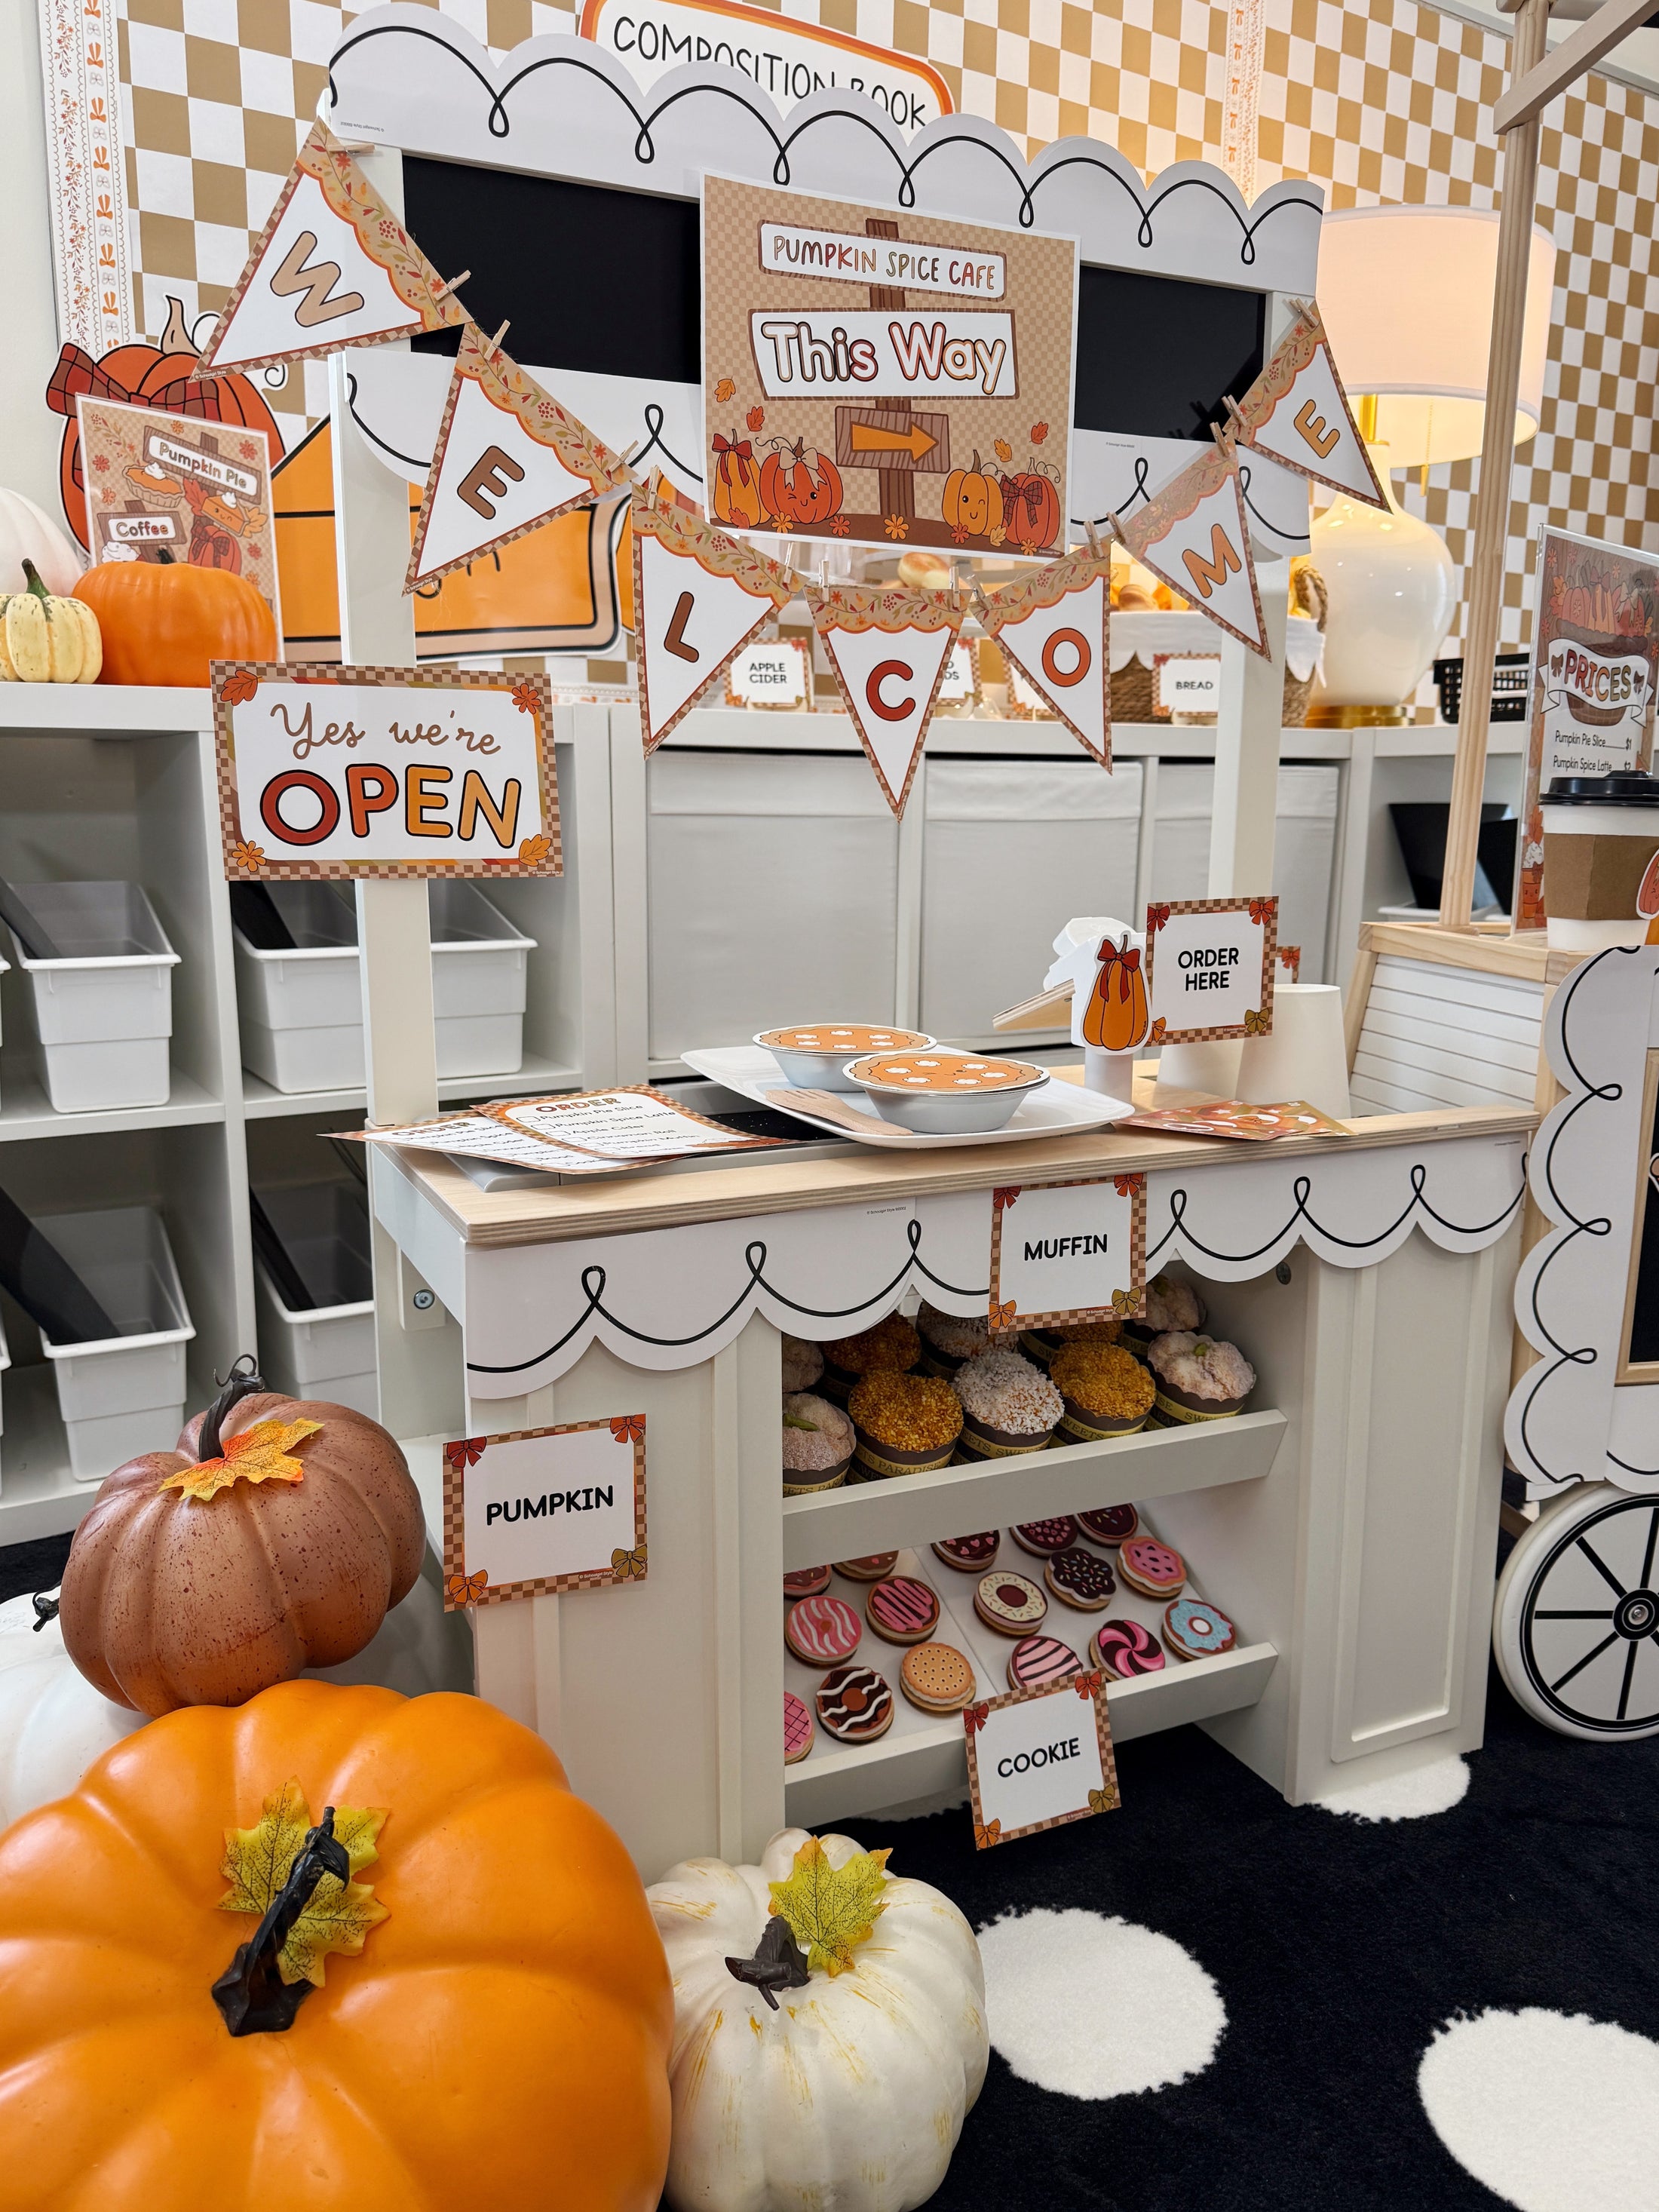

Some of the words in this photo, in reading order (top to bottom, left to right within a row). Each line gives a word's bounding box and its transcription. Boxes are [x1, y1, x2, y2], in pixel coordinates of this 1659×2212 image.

[773, 235, 877, 274] PUMPKIN
[885, 251, 940, 283] SPICE
[949, 259, 995, 291] CAFE
[760, 321, 879, 383] This
[888, 321, 1007, 395] Way
[158, 441, 222, 478] Pumpkin
[225, 464, 247, 489] Pie
[115, 520, 169, 537] Coffee
[749, 662, 786, 673] APPLE
[1563, 649, 1632, 702] PRICES
[749, 674, 787, 684] CIDER
[1175, 681, 1213, 690] BREAD
[270, 701, 366, 760] Yes
[388, 709, 501, 755] we're
[1555, 729, 1581, 747] Pumpkin
[1581, 733, 1591, 746] Pie
[1592, 735, 1606, 748] Slice
[1625, 737, 1632, 751] $1
[1553, 755, 1579, 772] Pumpkin
[1580, 755, 1596, 773] Spice
[1597, 759, 1612, 772] Latte
[259, 762, 523, 850] OPEN
[1177, 947, 1240, 969] ORDER
[1185, 970, 1231, 992] HERE
[535, 1097, 621, 1112] ORDER
[540, 1111, 593, 1120] Pumpkin
[555, 1119, 609, 1127] Pumpkin
[1024, 1233, 1108, 1262] MUFFIN
[486, 1484, 614, 1526] PUMPKIN
[997, 1737, 1081, 1778] COOKIE
